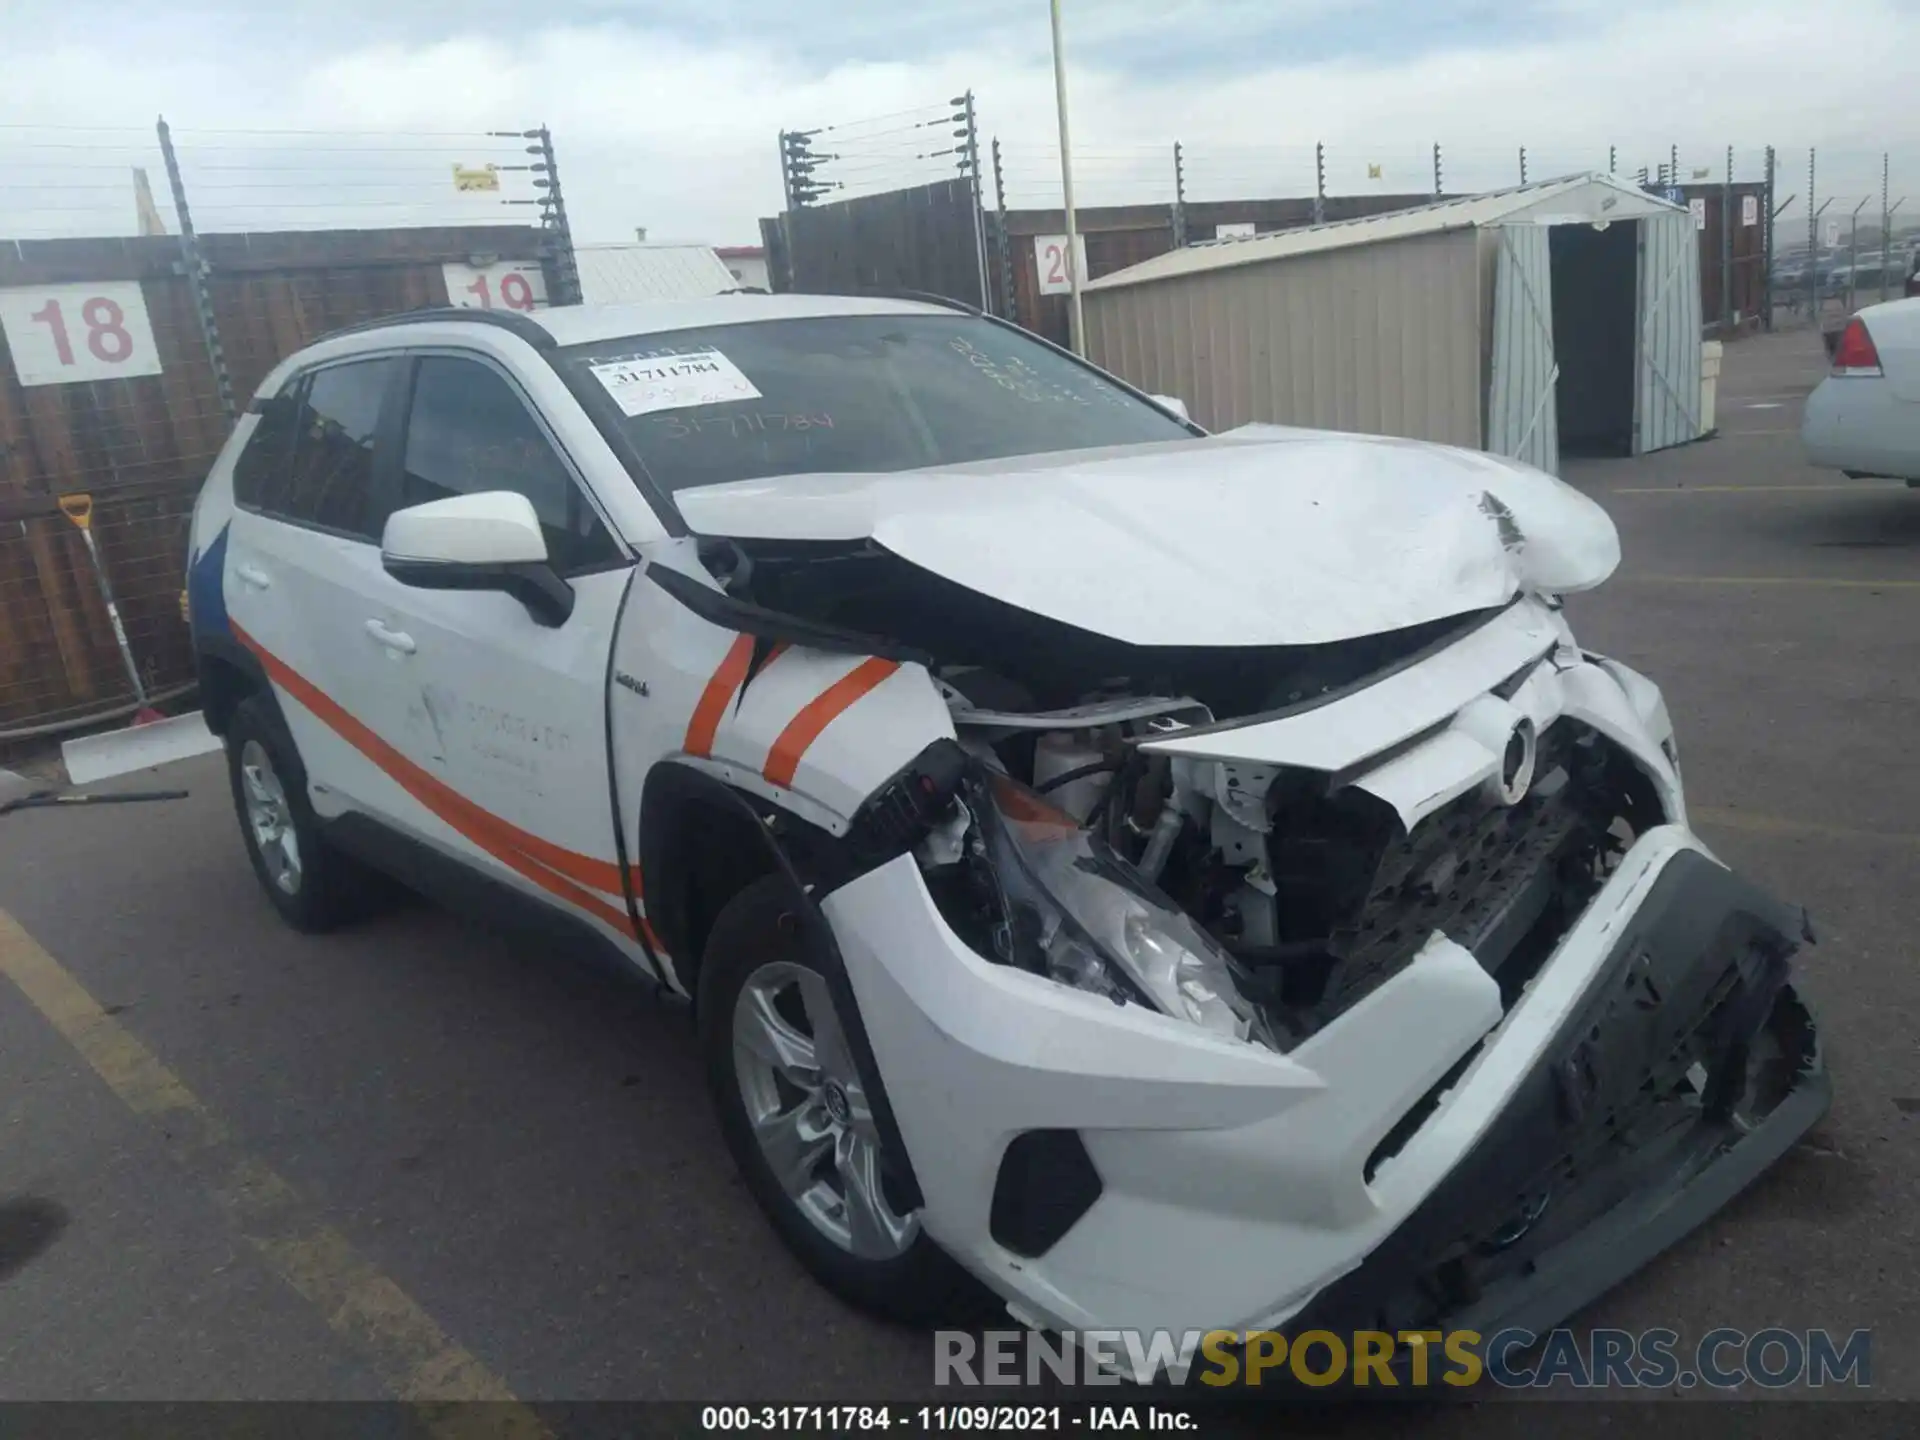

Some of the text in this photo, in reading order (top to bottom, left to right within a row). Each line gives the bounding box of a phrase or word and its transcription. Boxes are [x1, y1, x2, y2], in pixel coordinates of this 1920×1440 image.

[466, 273, 535, 312] 19
[30, 297, 134, 366] 18
[613, 362, 720, 384] 31711784
